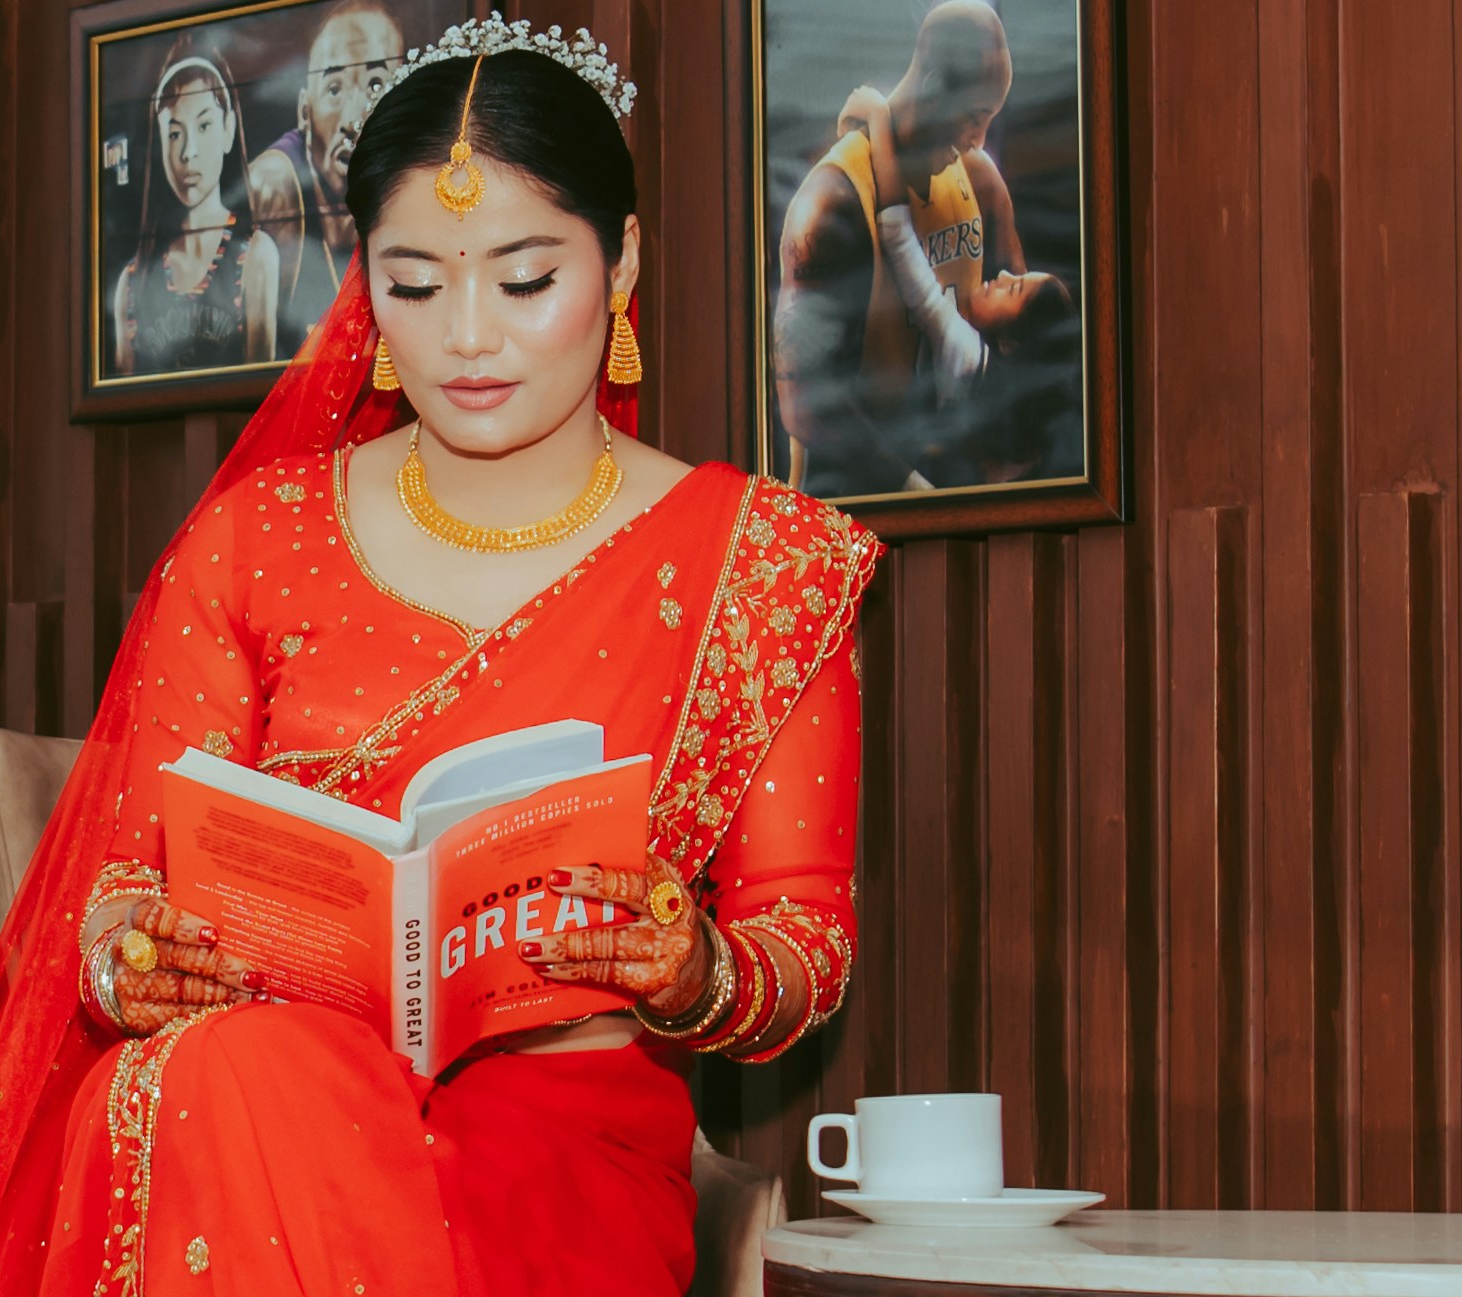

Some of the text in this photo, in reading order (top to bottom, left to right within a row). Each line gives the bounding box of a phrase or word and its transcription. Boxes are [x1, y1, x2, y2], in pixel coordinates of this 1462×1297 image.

[920, 217, 983, 268] KERS
[456, 837, 486, 858] THREE
[491, 818, 535, 841] MILLION
[540, 804, 580, 822] COPIES
[586, 796, 614, 810] SOLD
[514, 796, 580, 823] BESTSELLER
[462, 876, 543, 917] GOOD
[405, 918, 421, 963] GOOD
[406, 969, 421, 990] TO
[406, 997, 423, 1048] GREAT
